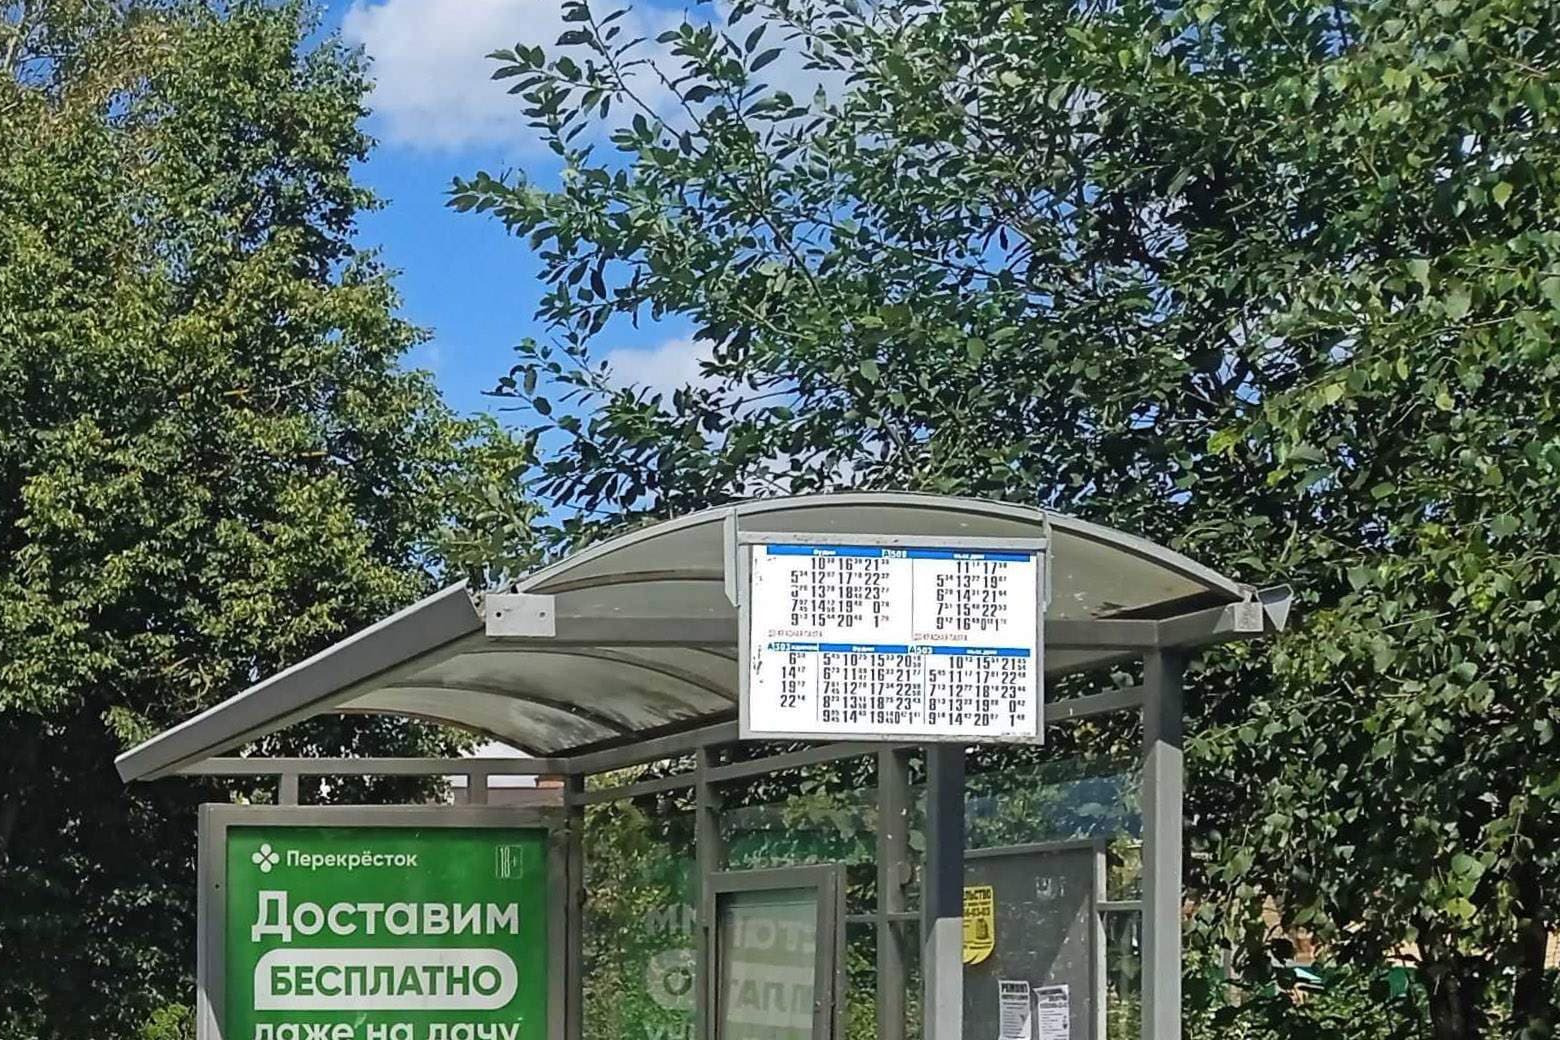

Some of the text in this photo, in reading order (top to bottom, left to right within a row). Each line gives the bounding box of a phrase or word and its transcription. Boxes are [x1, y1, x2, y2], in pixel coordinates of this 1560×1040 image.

[811, 558, 879, 571] 10 16 21
[957, 562, 997, 574] 11 17
[791, 571, 798, 583] 5
[812, 572, 825, 584] 12
[839, 572, 852, 584] 17
[865, 573, 880, 585] 22
[937, 575, 944, 587] 5
[957, 575, 970, 588] 13
[984, 576, 997, 588] 19
[812, 586, 825, 598] 13
[839, 586, 852, 599] 18
[865, 587, 880, 599] 23
[937, 589, 944, 601] 6
[957, 590, 970, 602] 14
[983, 590, 996, 602] 21
[792, 599, 798, 612] 7
[812, 600, 825, 612] 14
[839, 601, 852, 612] 19
[936, 603, 943, 615] 7
[957, 604, 970, 616] 15
[982, 604, 997, 617] 22
[791, 614, 798, 626] 9
[812, 614, 825, 626] 15
[838, 614, 852, 627] 20
[937, 617, 944, 629] 9
[957, 618, 970, 630] 16
[789, 653, 796, 664] 6
[823, 653, 831, 665] 5
[844, 654, 857, 666] 10
[871, 655, 884, 667] 15
[897, 655, 911, 667] 20
[950, 657, 963, 669] 10
[977, 657, 990, 669] 15
[1002, 658, 1016, 670] 21
[782, 667, 795, 679] 14
[824, 667, 831, 679] 6
[844, 668, 856, 680] 11
[871, 669, 884, 681] 16
[897, 669, 910, 681] 21
[929, 670, 936, 682] 5
[949, 671, 961, 682] 11
[976, 671, 990, 683] 17
[1001, 672, 1016, 684] 22
[782, 681, 796, 693] 19
[824, 681, 830, 694] 7
[844, 682, 857, 694] 12
[871, 683, 884, 695] 17
[896, 683, 911, 696] 22
[930, 684, 936, 696] 7
[949, 685, 963, 697] 12
[1001, 686, 1016, 698] 23
[781, 695, 796, 707] 22
[843, 696, 857, 708] 13
[871, 697, 884, 709] 18
[896, 698, 911, 710] 23
[949, 699, 963, 711] 13
[976, 700, 989, 712] 19
[823, 710, 830, 722] 9
[843, 711, 857, 723] 14
[871, 711, 884, 724] 19
[929, 713, 936, 724] 9
[949, 713, 962, 725] 14
[974, 714, 989, 726] 20
[287, 850, 418, 872] Перекрёсток
[251, 890, 519, 942] Доставим
[270, 965, 502, 997] БЕСПЛАТНО
